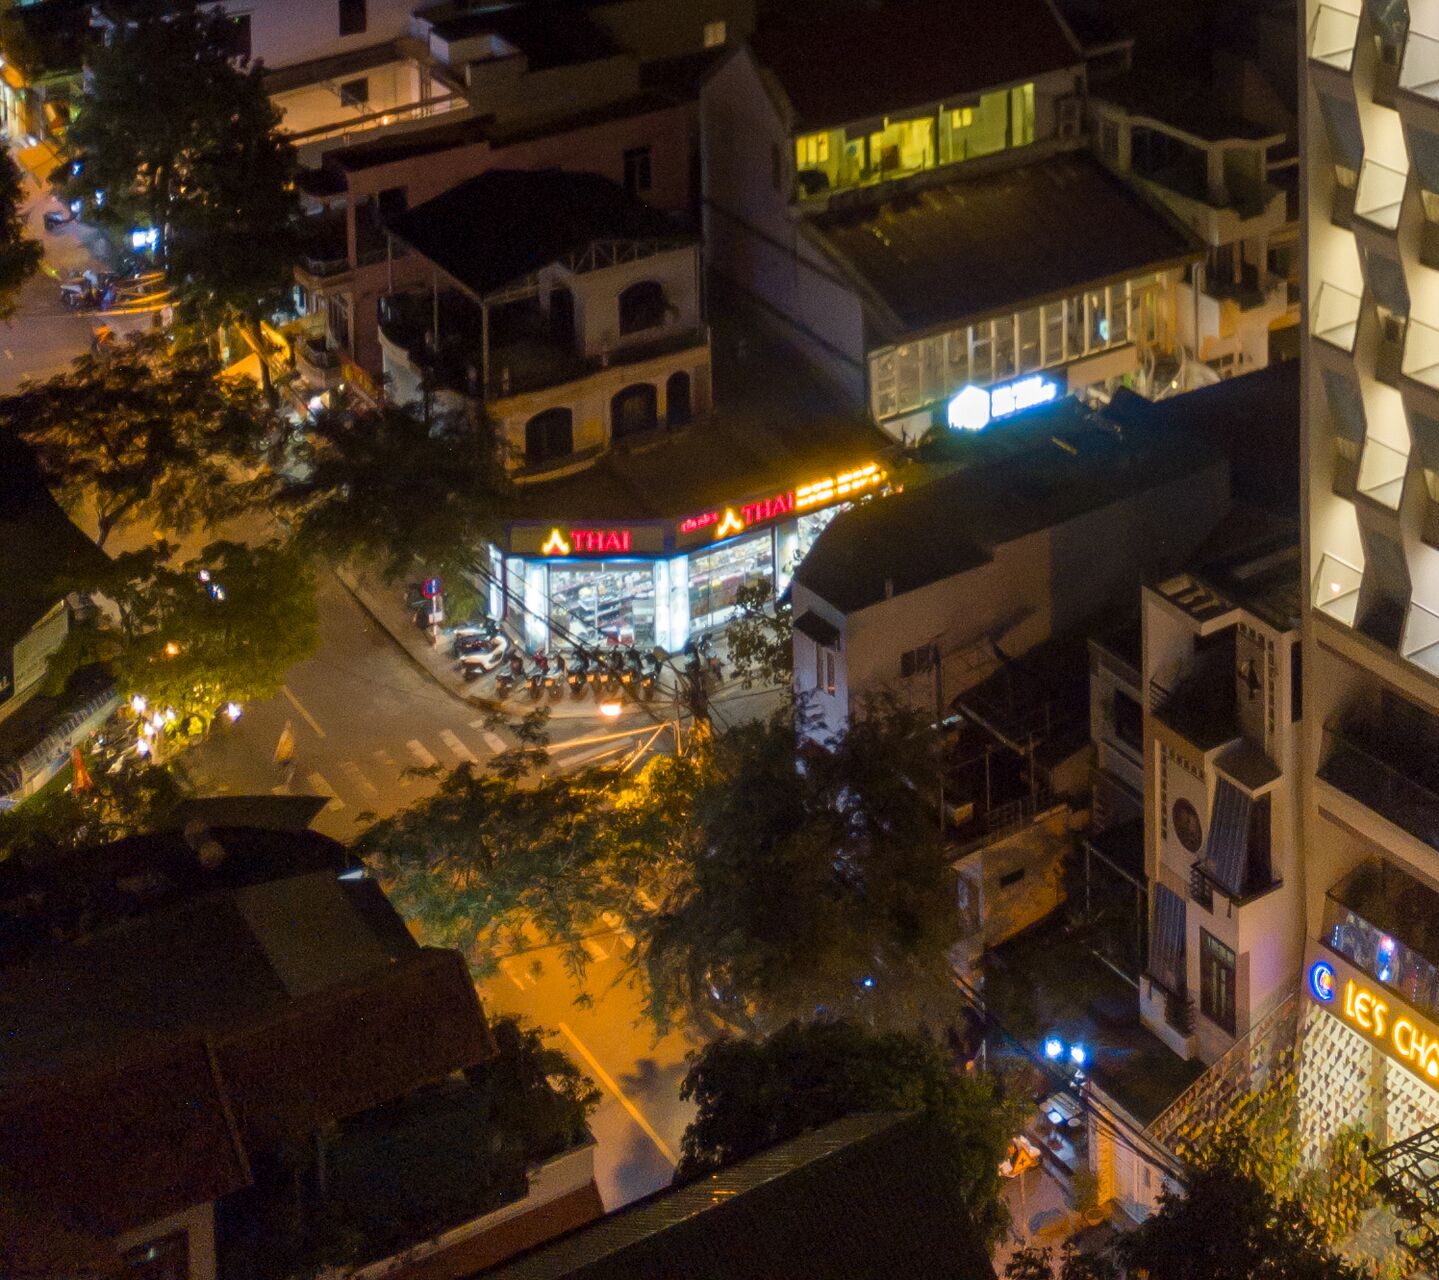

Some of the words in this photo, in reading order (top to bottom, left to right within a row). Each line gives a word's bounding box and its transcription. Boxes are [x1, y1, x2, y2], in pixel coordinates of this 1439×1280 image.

[741, 491, 795, 525] THAI
[571, 530, 631, 553] THAI
[1344, 981, 1389, 1037] LE'S
